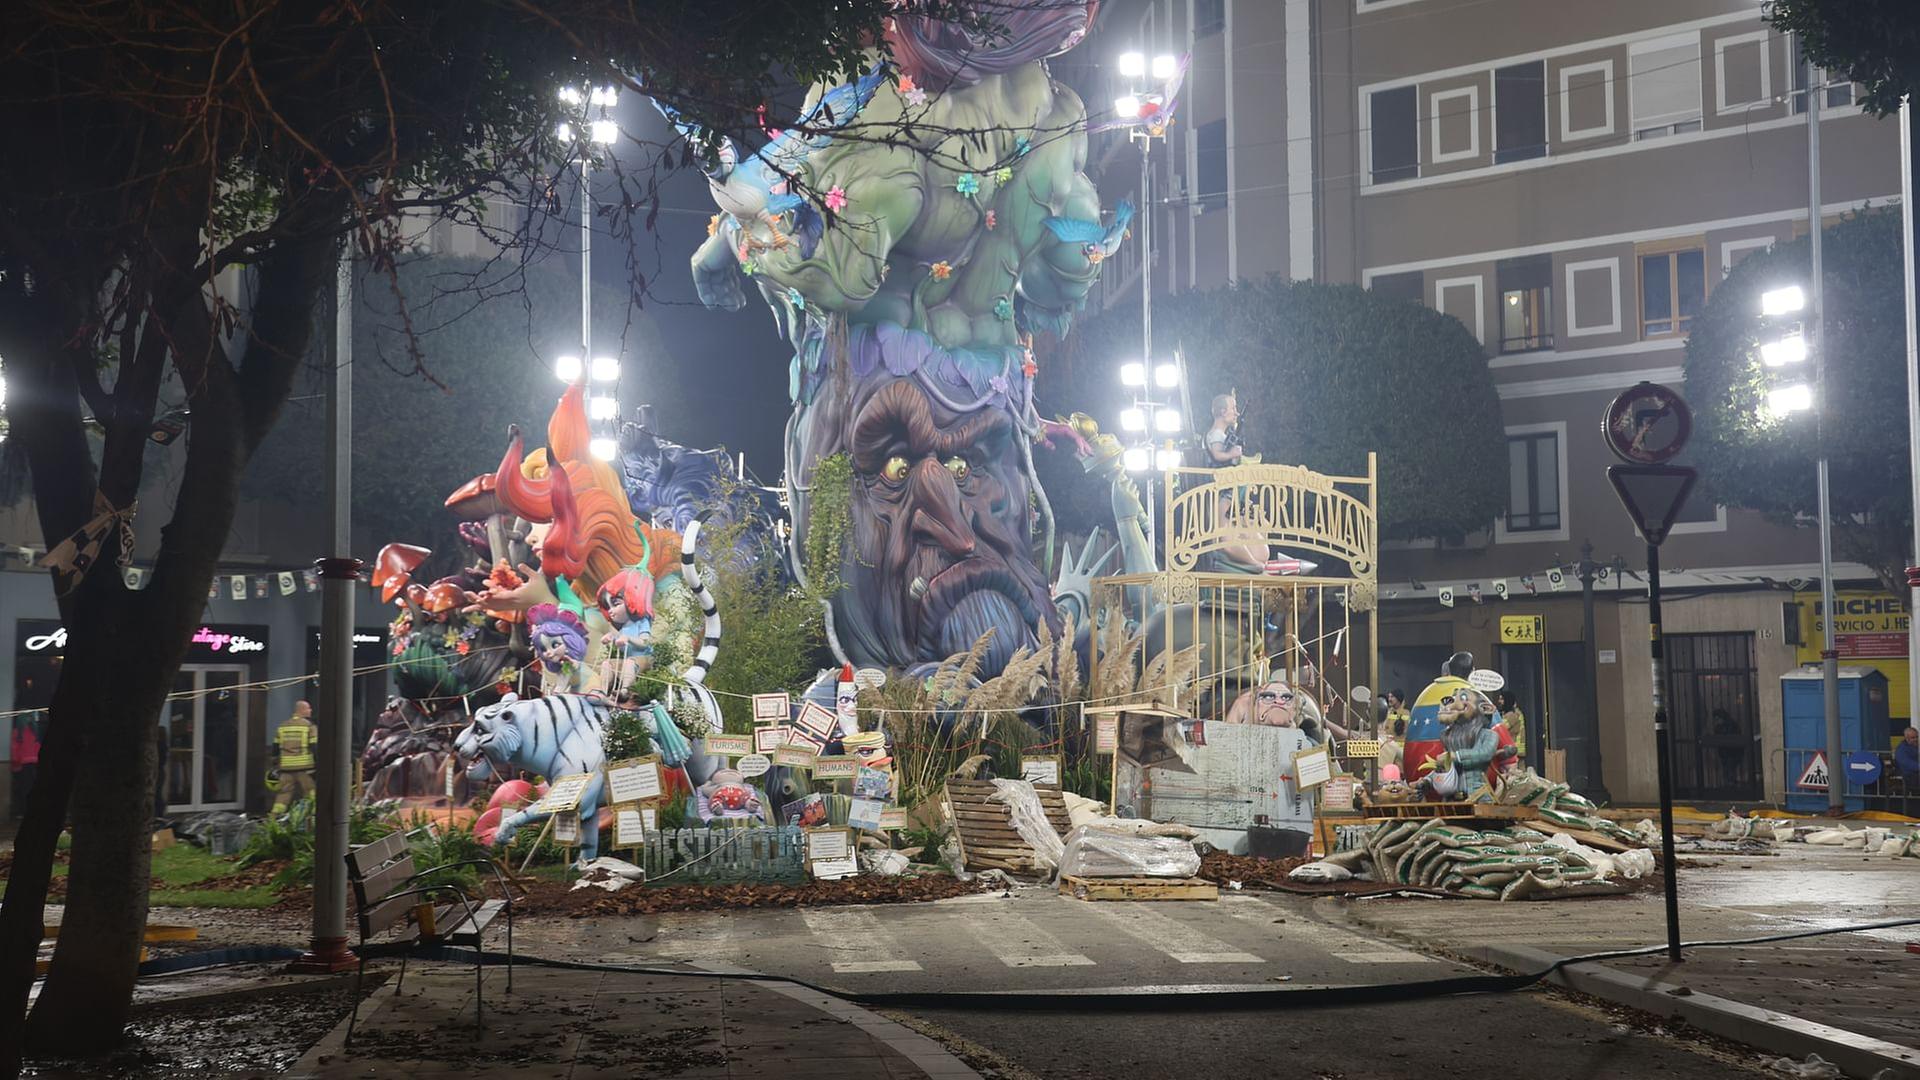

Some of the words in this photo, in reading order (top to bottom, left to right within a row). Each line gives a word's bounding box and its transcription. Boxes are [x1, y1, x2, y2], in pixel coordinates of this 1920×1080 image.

[1815, 620, 1875, 632] SRVICIO
[229, 635, 265, 653] Store
[710, 741, 747, 751] TURISME
[818, 762, 854, 773] HUMANS
